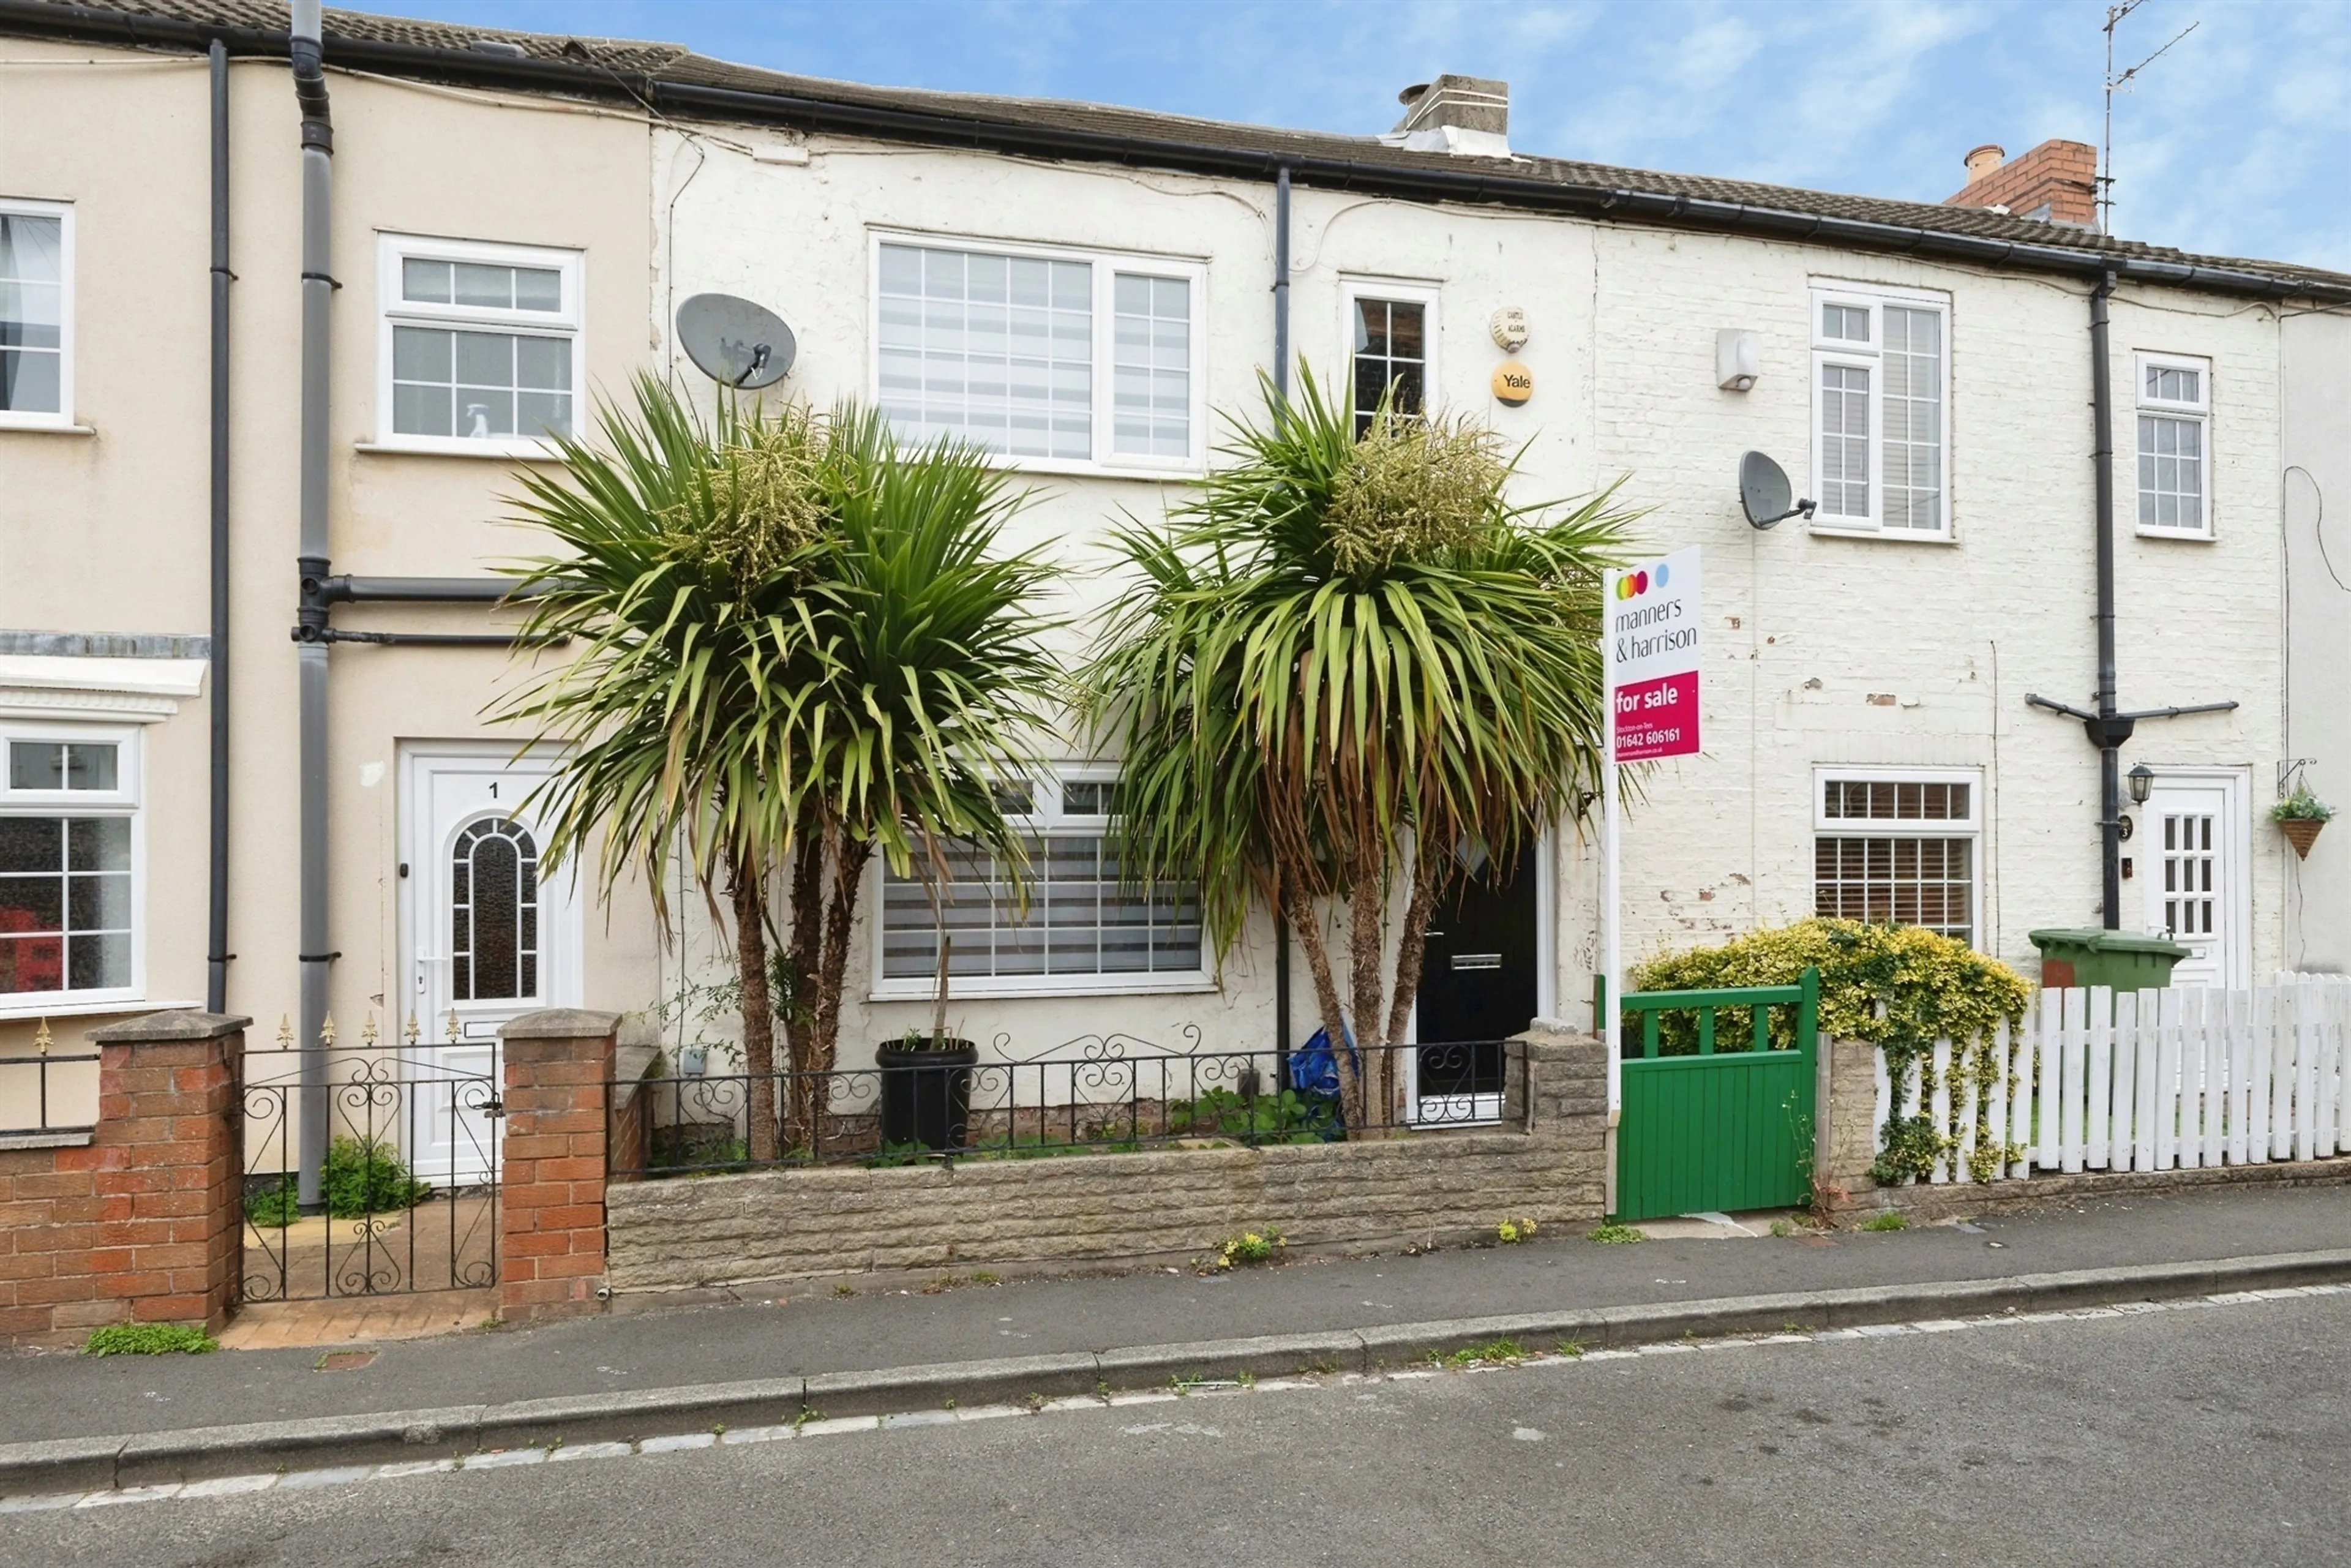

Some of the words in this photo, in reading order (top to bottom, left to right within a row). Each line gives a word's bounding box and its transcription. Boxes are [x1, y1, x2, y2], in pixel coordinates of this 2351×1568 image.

[1504, 374, 1531, 389] Yale
[1616, 599, 1682, 633] manners
[1616, 637, 1627, 663] &
[1631, 627, 1697, 659] harrison
[1616, 691, 1640, 713] for
[1644, 683, 1678, 709] sale
[1616, 733, 1644, 749] 01642
[1646, 728, 1680, 745] 606161
[489, 782, 498, 798] 1
[2122, 828, 2128, 838] 3
